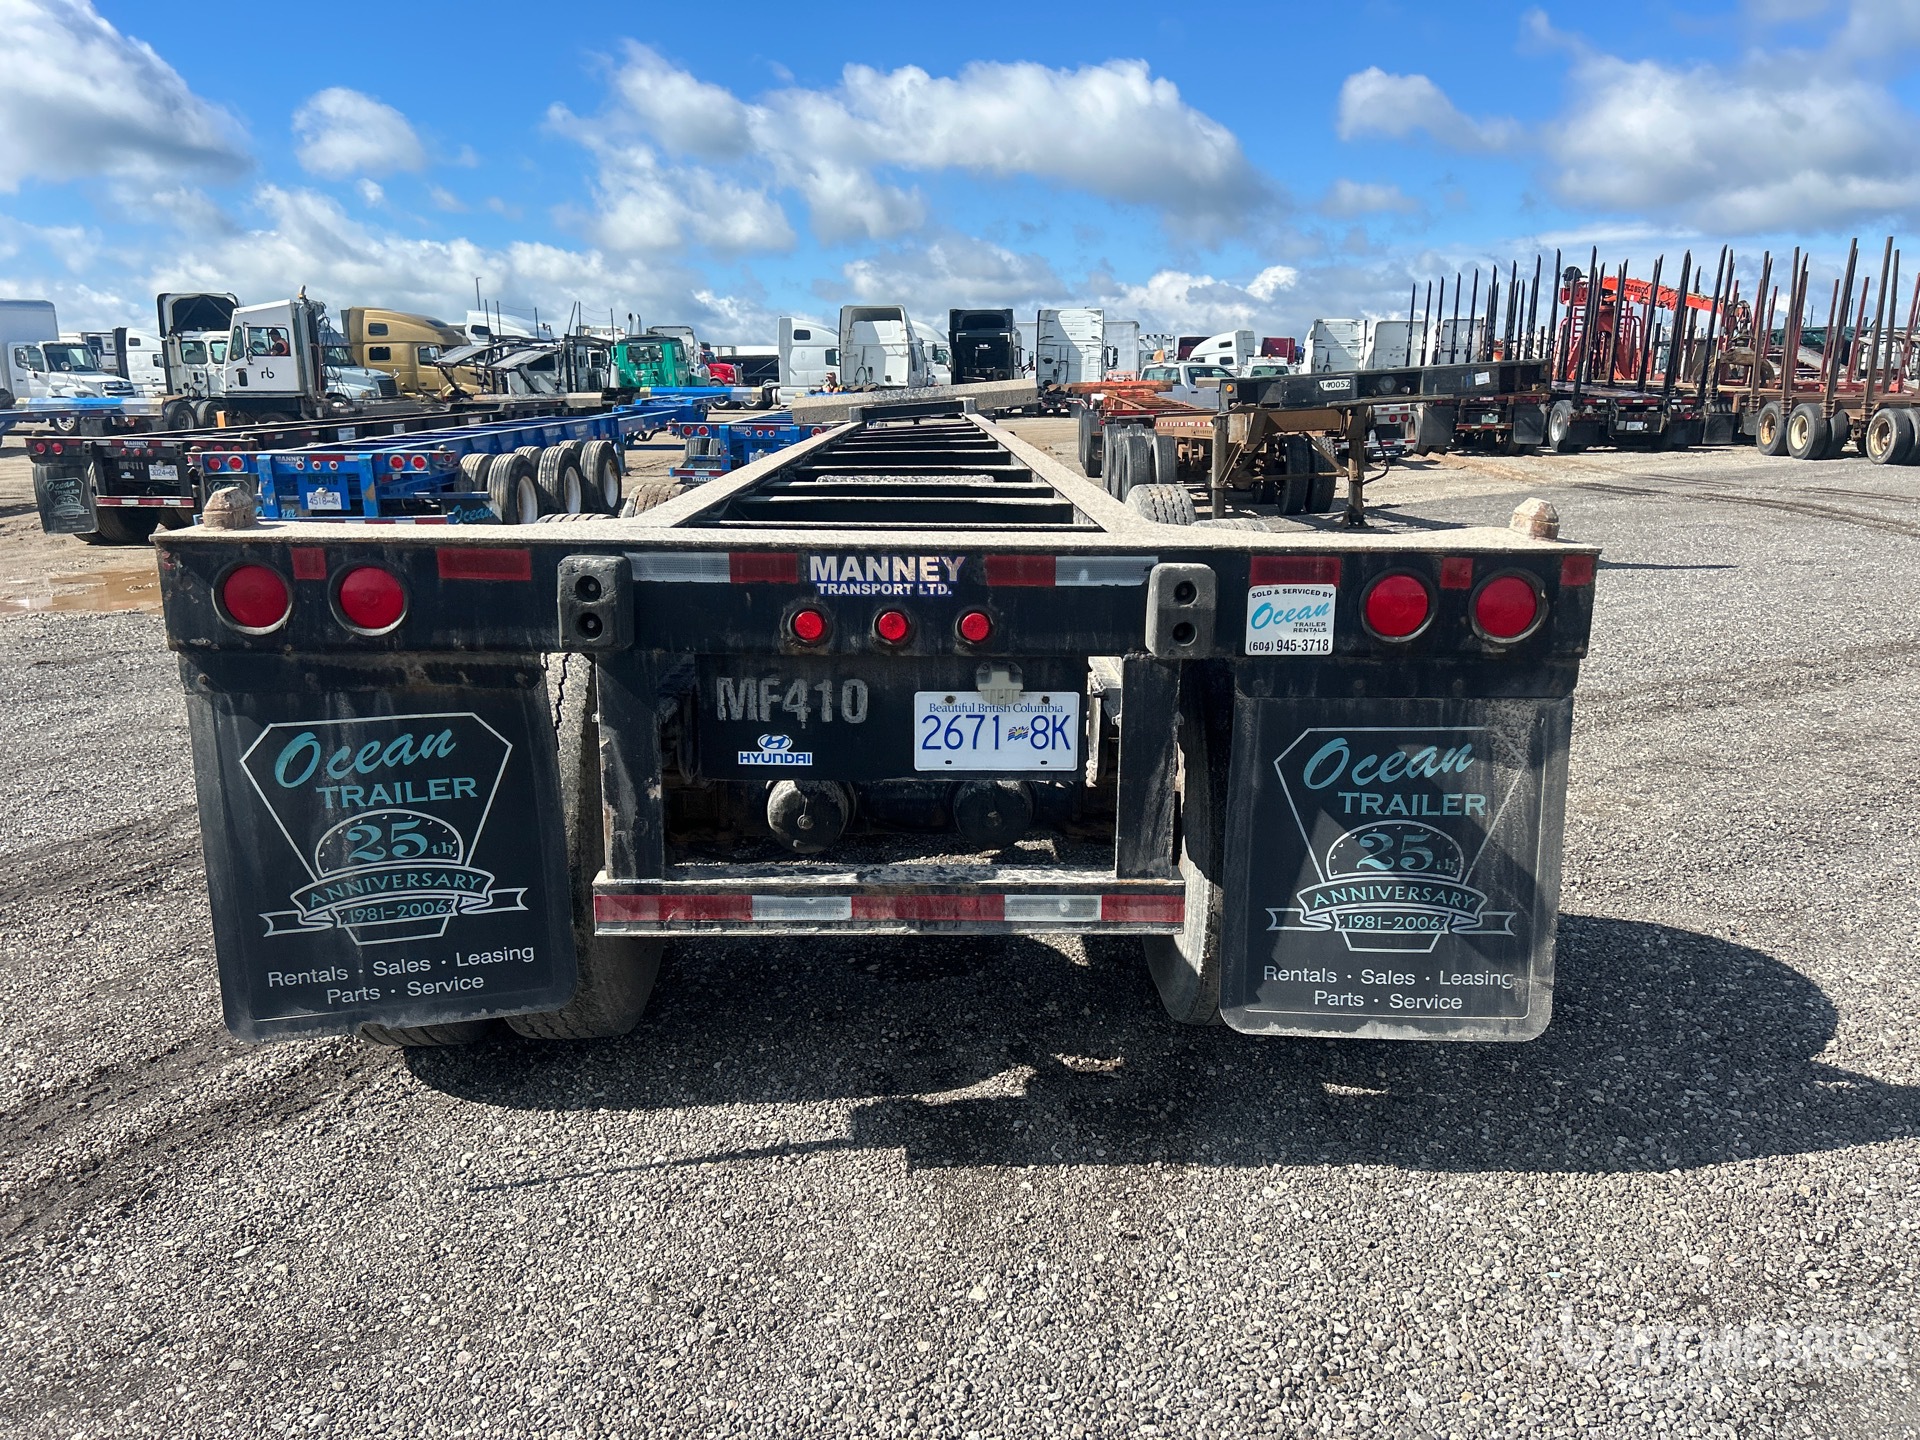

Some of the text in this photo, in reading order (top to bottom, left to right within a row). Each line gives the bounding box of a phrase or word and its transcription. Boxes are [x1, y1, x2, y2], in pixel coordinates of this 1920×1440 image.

[261, 367, 275, 379] rb
[309, 497, 327, 505] 4518
[452, 504, 494, 523] Ocean
[810, 556, 966, 582] MANNEY
[817, 583, 952, 595] TRANSPORT LTD.
[1251, 590, 1272, 599] SOLD
[1282, 588, 1321, 596] SERVICED
[1322, 591, 1333, 599] BY
[1251, 602, 1331, 630] Ocean
[1249, 639, 1329, 652] (604) 945-3718
[716, 677, 869, 724] MF410
[929, 702, 1063, 713] Beautiful British Columbia
[921, 715, 1071, 750] 2671 8K
[274, 729, 456, 788] Ocean
[739, 752, 811, 764] HYUNDAI
[1303, 737, 1475, 790] Ocean
[315, 777, 478, 809] TRAILER
[1338, 791, 1487, 817] TRAILER
[309, 872, 481, 908] ANNIVERSARY
[1313, 885, 1476, 909] ANNIVERSARY
[268, 946, 535, 988] Rentals Sales Leasing
[1263, 965, 1514, 989] Rentals Sales Leasing
[327, 974, 485, 1005] Parts Service
[1314, 990, 1463, 1010] Parts Service
